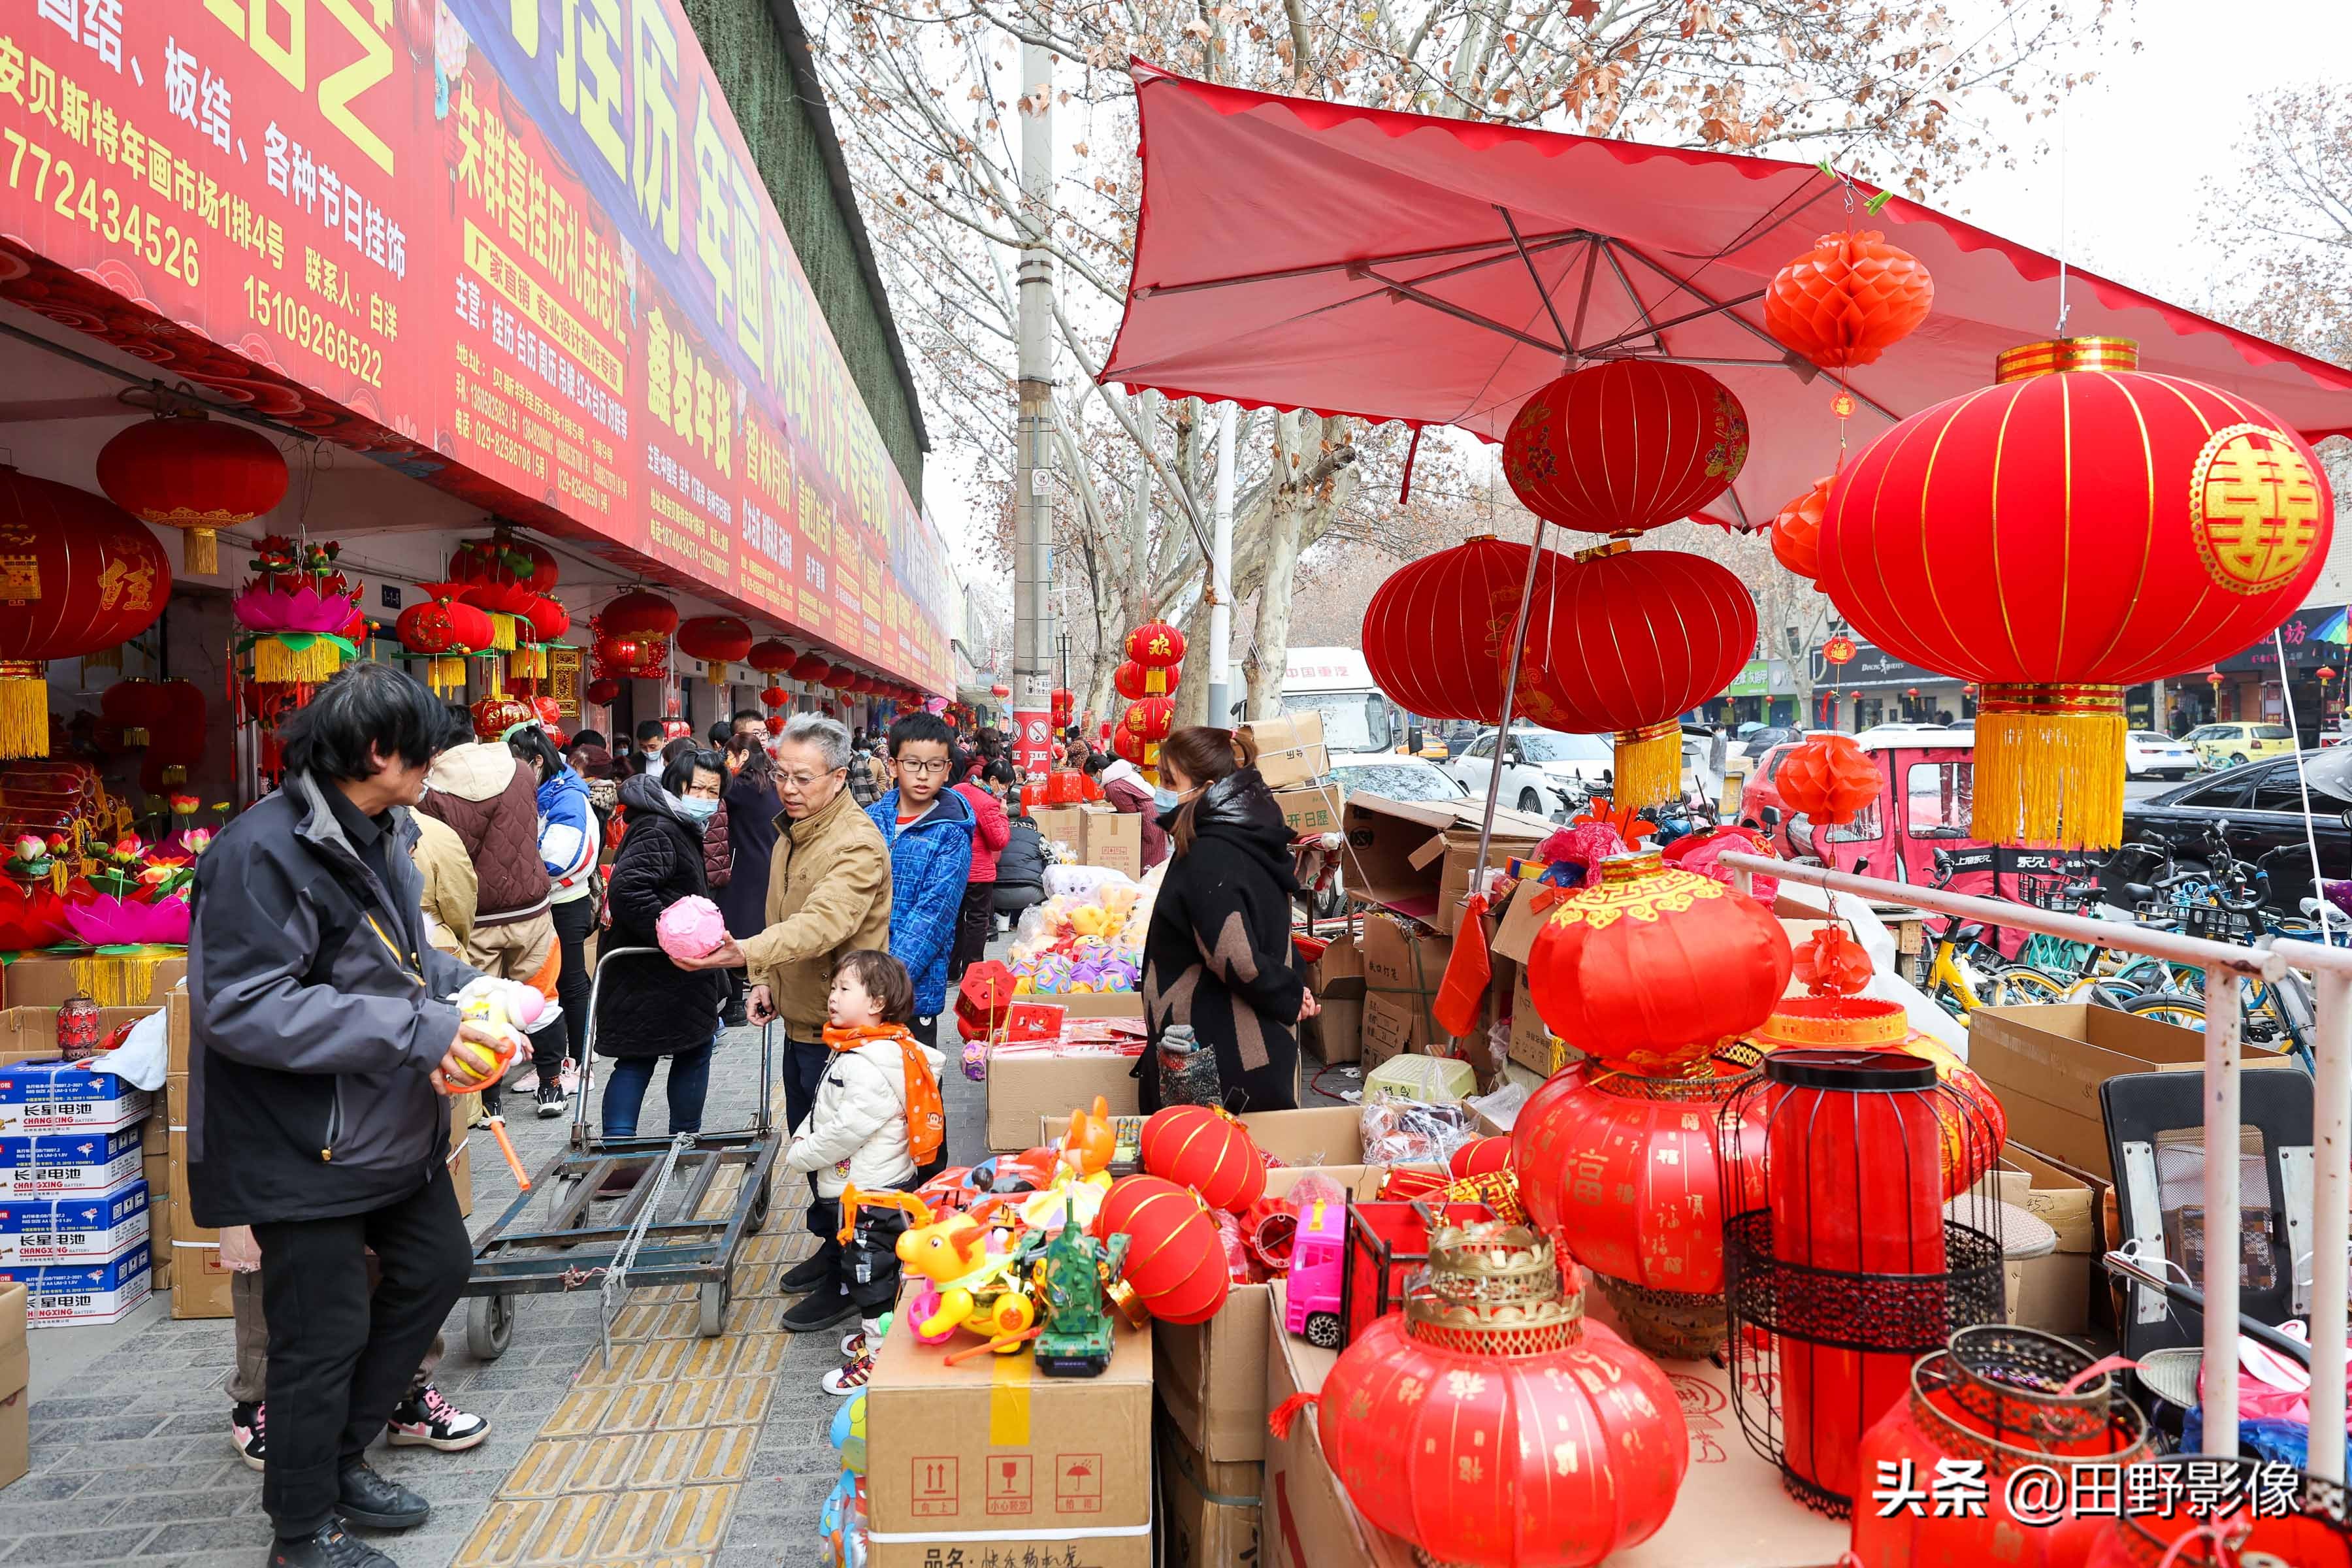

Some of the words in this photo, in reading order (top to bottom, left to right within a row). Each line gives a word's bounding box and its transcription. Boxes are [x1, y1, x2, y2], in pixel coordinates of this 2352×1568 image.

[475, 234, 531, 312] 厂家直销
[244, 275, 382, 389] 15109266522
[1149, 633, 1171, 657] 欢
[1285, 665, 1350, 679] 中国重汽
[24, 1103, 91, 1116] 长星电池
[14, 1169, 80, 1181] 长星电池
[20, 1233, 85, 1246] 长星电池
